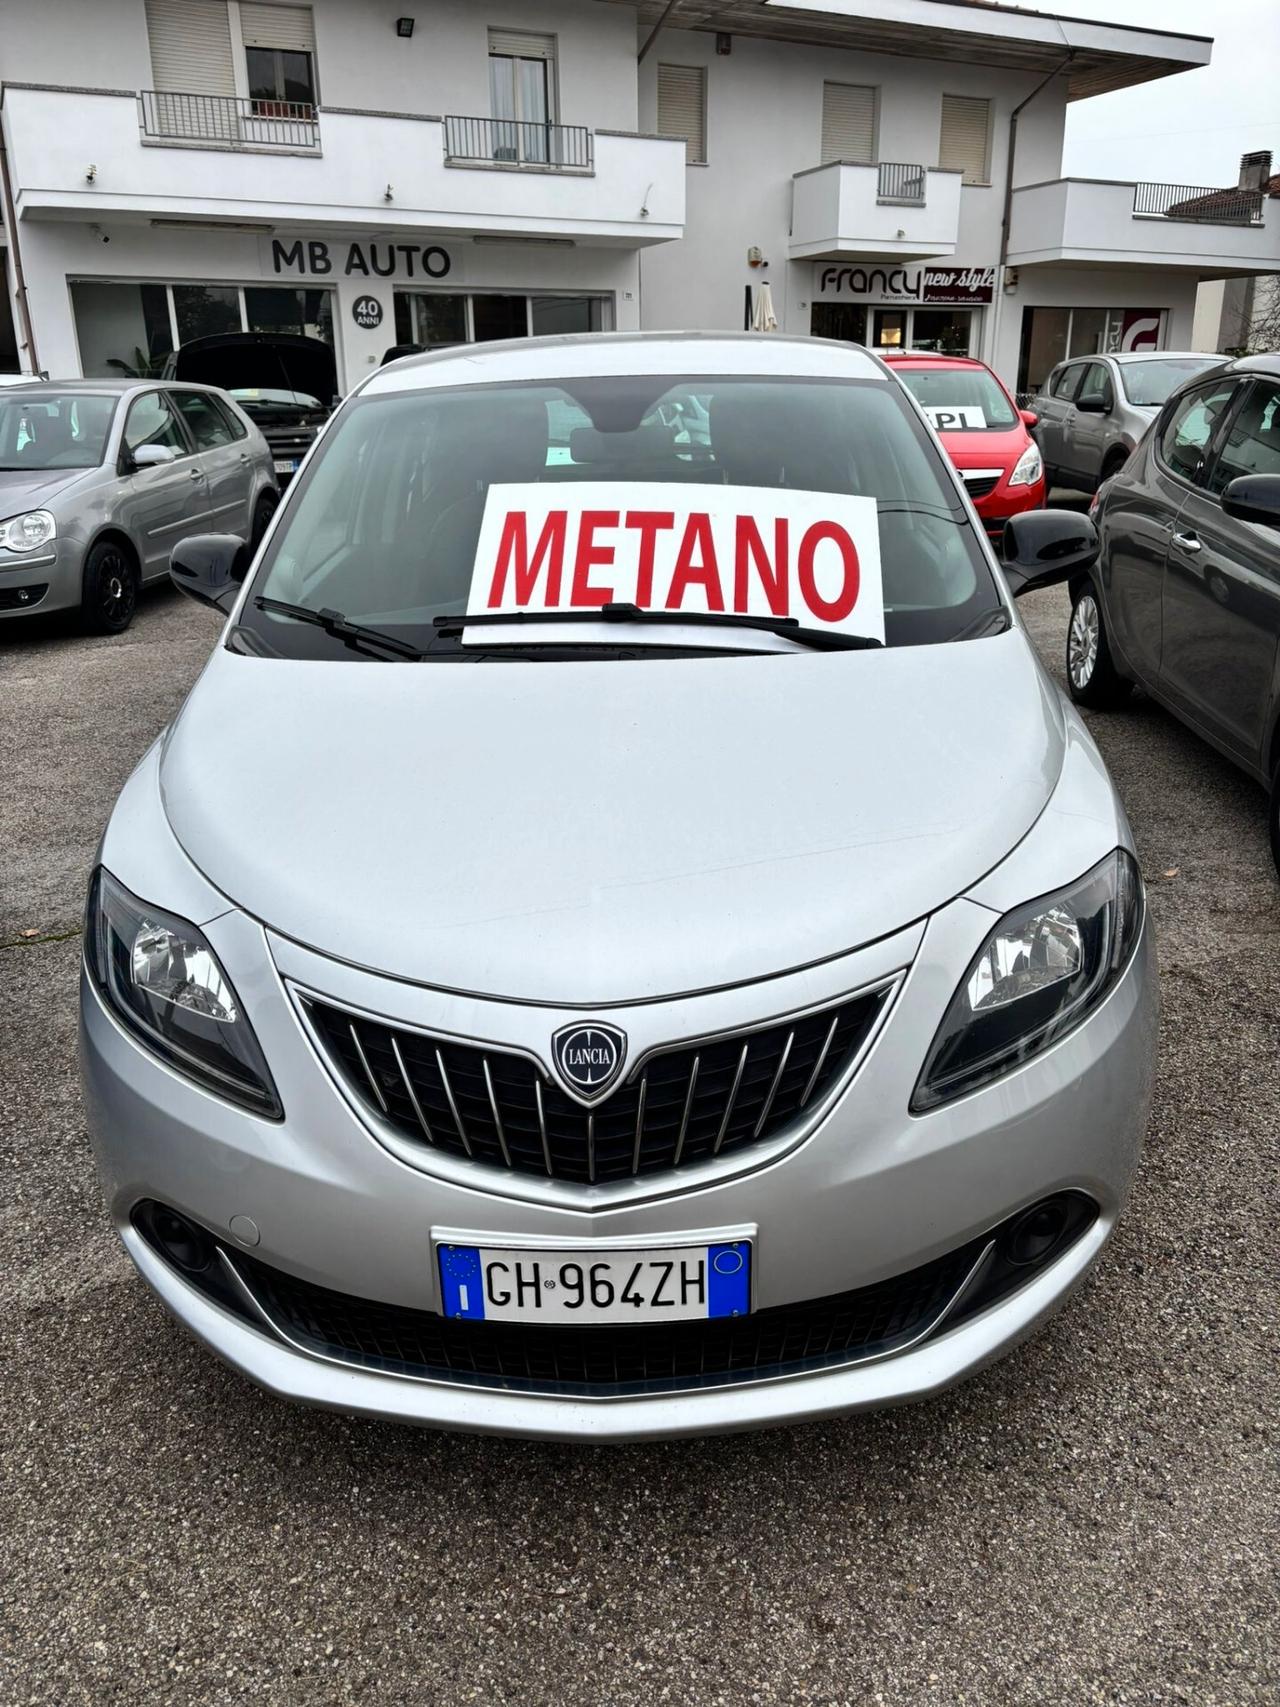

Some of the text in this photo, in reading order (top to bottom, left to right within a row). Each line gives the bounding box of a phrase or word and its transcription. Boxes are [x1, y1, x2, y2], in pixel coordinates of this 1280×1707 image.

[272, 239, 451, 278] MB AUTO
[923, 268, 994, 292] new style
[357, 300, 378, 316] 40
[357, 316, 379, 325] ANNI
[487, 510, 860, 623] METANO
[569, 1048, 611, 1065] LANCIA
